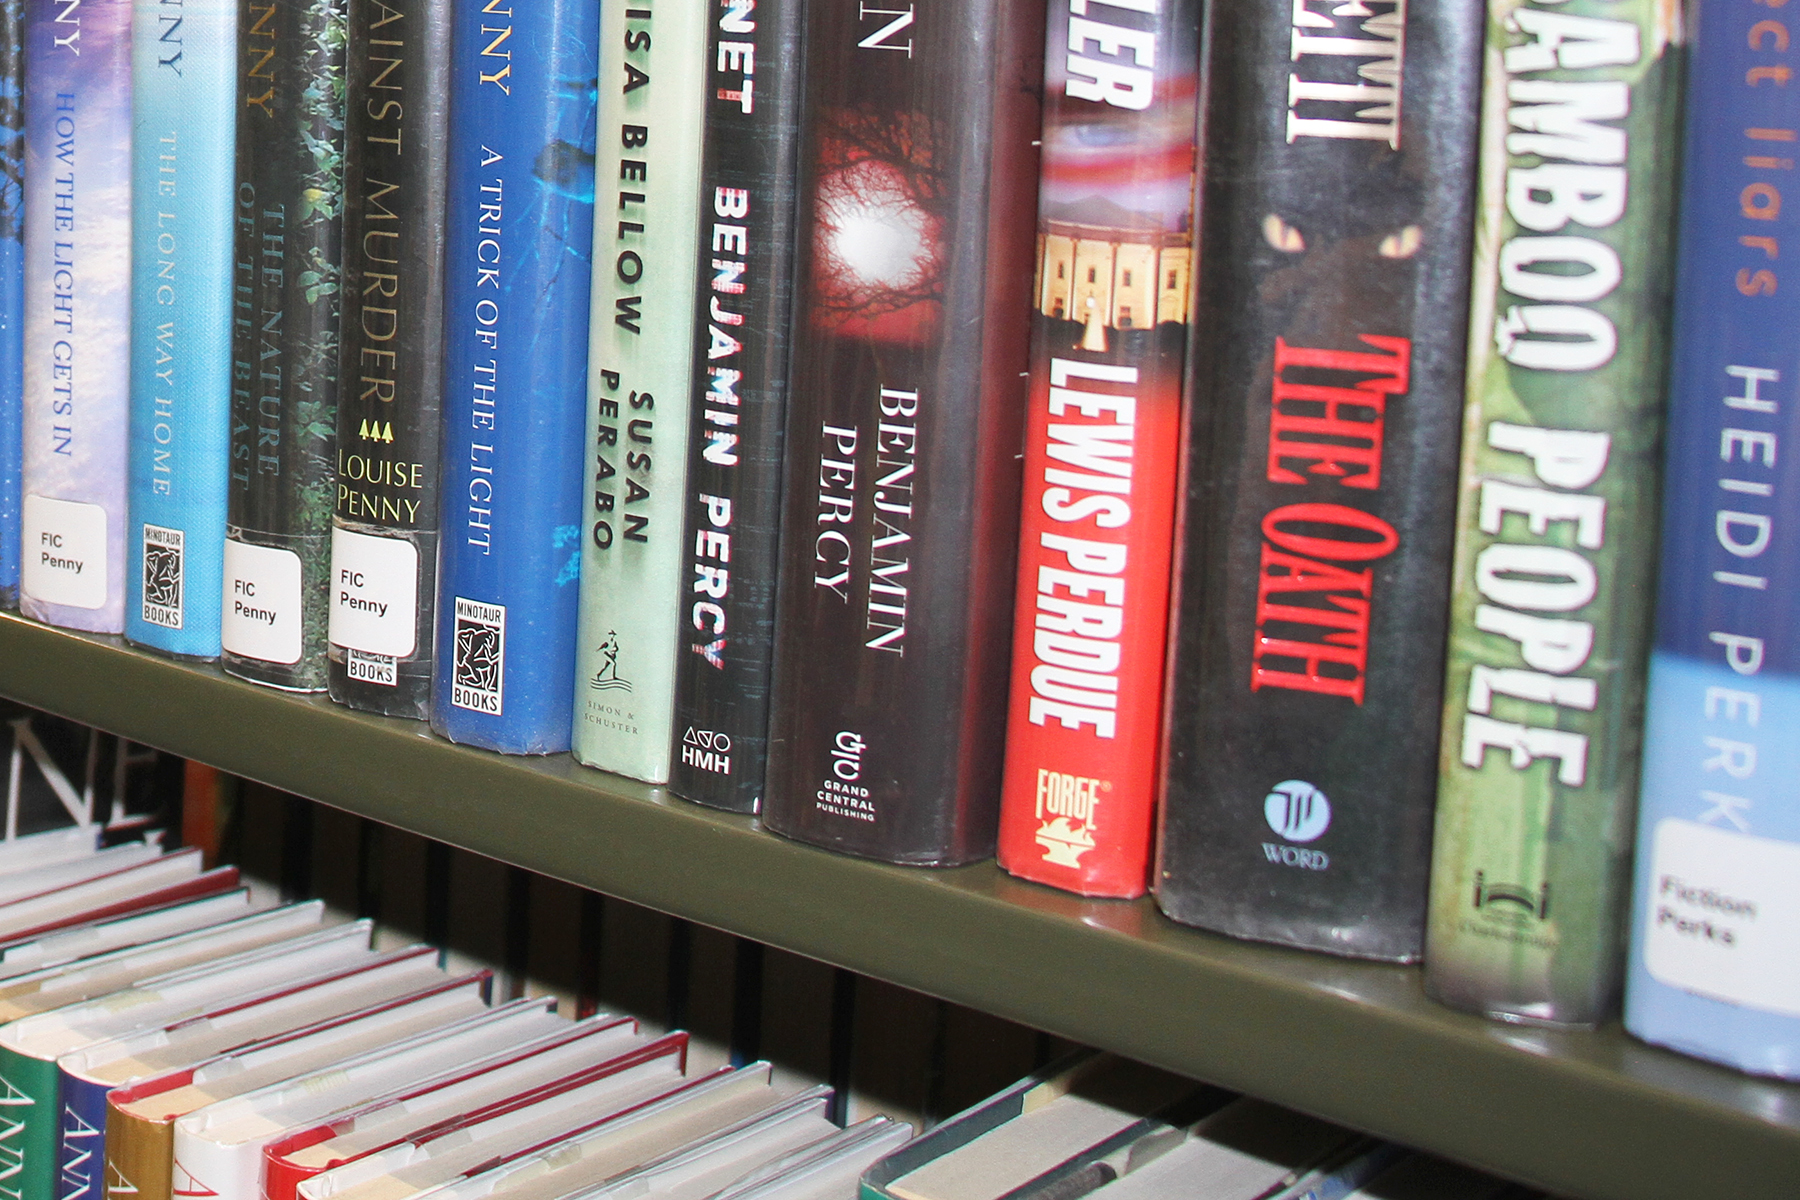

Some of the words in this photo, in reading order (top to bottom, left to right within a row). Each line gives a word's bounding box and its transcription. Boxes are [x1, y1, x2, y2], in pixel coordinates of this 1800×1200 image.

[54, 91, 77, 168] HOW
[157, 131, 178, 198] THE
[479, 144, 504, 168] A
[53, 172, 76, 233] THE
[475, 178, 502, 290] TRICK
[613, 123, 649, 337] BELLOW
[1733, 125, 1797, 300] liars
[52, 240, 75, 336] LIGHT
[156, 209, 177, 309] LONG
[359, 178, 401, 405] MURDER
[154, 320, 175, 387] WAY
[472, 296, 499, 351] OF
[702, 185, 750, 468] BENJAMIN
[51, 340, 73, 416] GETS
[471, 358, 498, 431] THE
[1266, 333, 1411, 491] THE
[51, 423, 72, 458] IN
[151, 394, 175, 498] HOME
[336, 447, 425, 490] LOUISE
[592, 368, 620, 552] PERABO
[622, 389, 655, 546] SUSAN
[1041, 354, 1139, 532] LEWIS
[336, 484, 422, 524] PENNY
[466, 440, 494, 556] LIGHT
[812, 419, 860, 604] PERCY
[1711, 364, 1781, 591] HEIDI
[40, 531, 63, 549] FIC
[863, 382, 921, 659] BENJAMIN
[40, 551, 84, 576] Penny
[233, 578, 256, 598] FIC
[340, 568, 365, 589] FIC
[691, 491, 733, 672] PERCY
[143, 604, 181, 627] BOOKS
[233, 600, 278, 627] Penny
[340, 591, 389, 618] Penny
[455, 600, 502, 625] MINOTAUR
[1028, 531, 1130, 740] PERDUE
[1250, 501, 1400, 706] OATH
[1460, 420, 1613, 789] PEOPLE
[349, 660, 394, 684] BOOKS
[453, 686, 500, 714] BOOKS
[680, 744, 732, 776] HMH
[823, 777, 870, 799] GRAND
[816, 787, 876, 815] CENTRAL
[1656, 906, 1738, 949] Perks
[1659, 874, 1758, 920] Fiction
